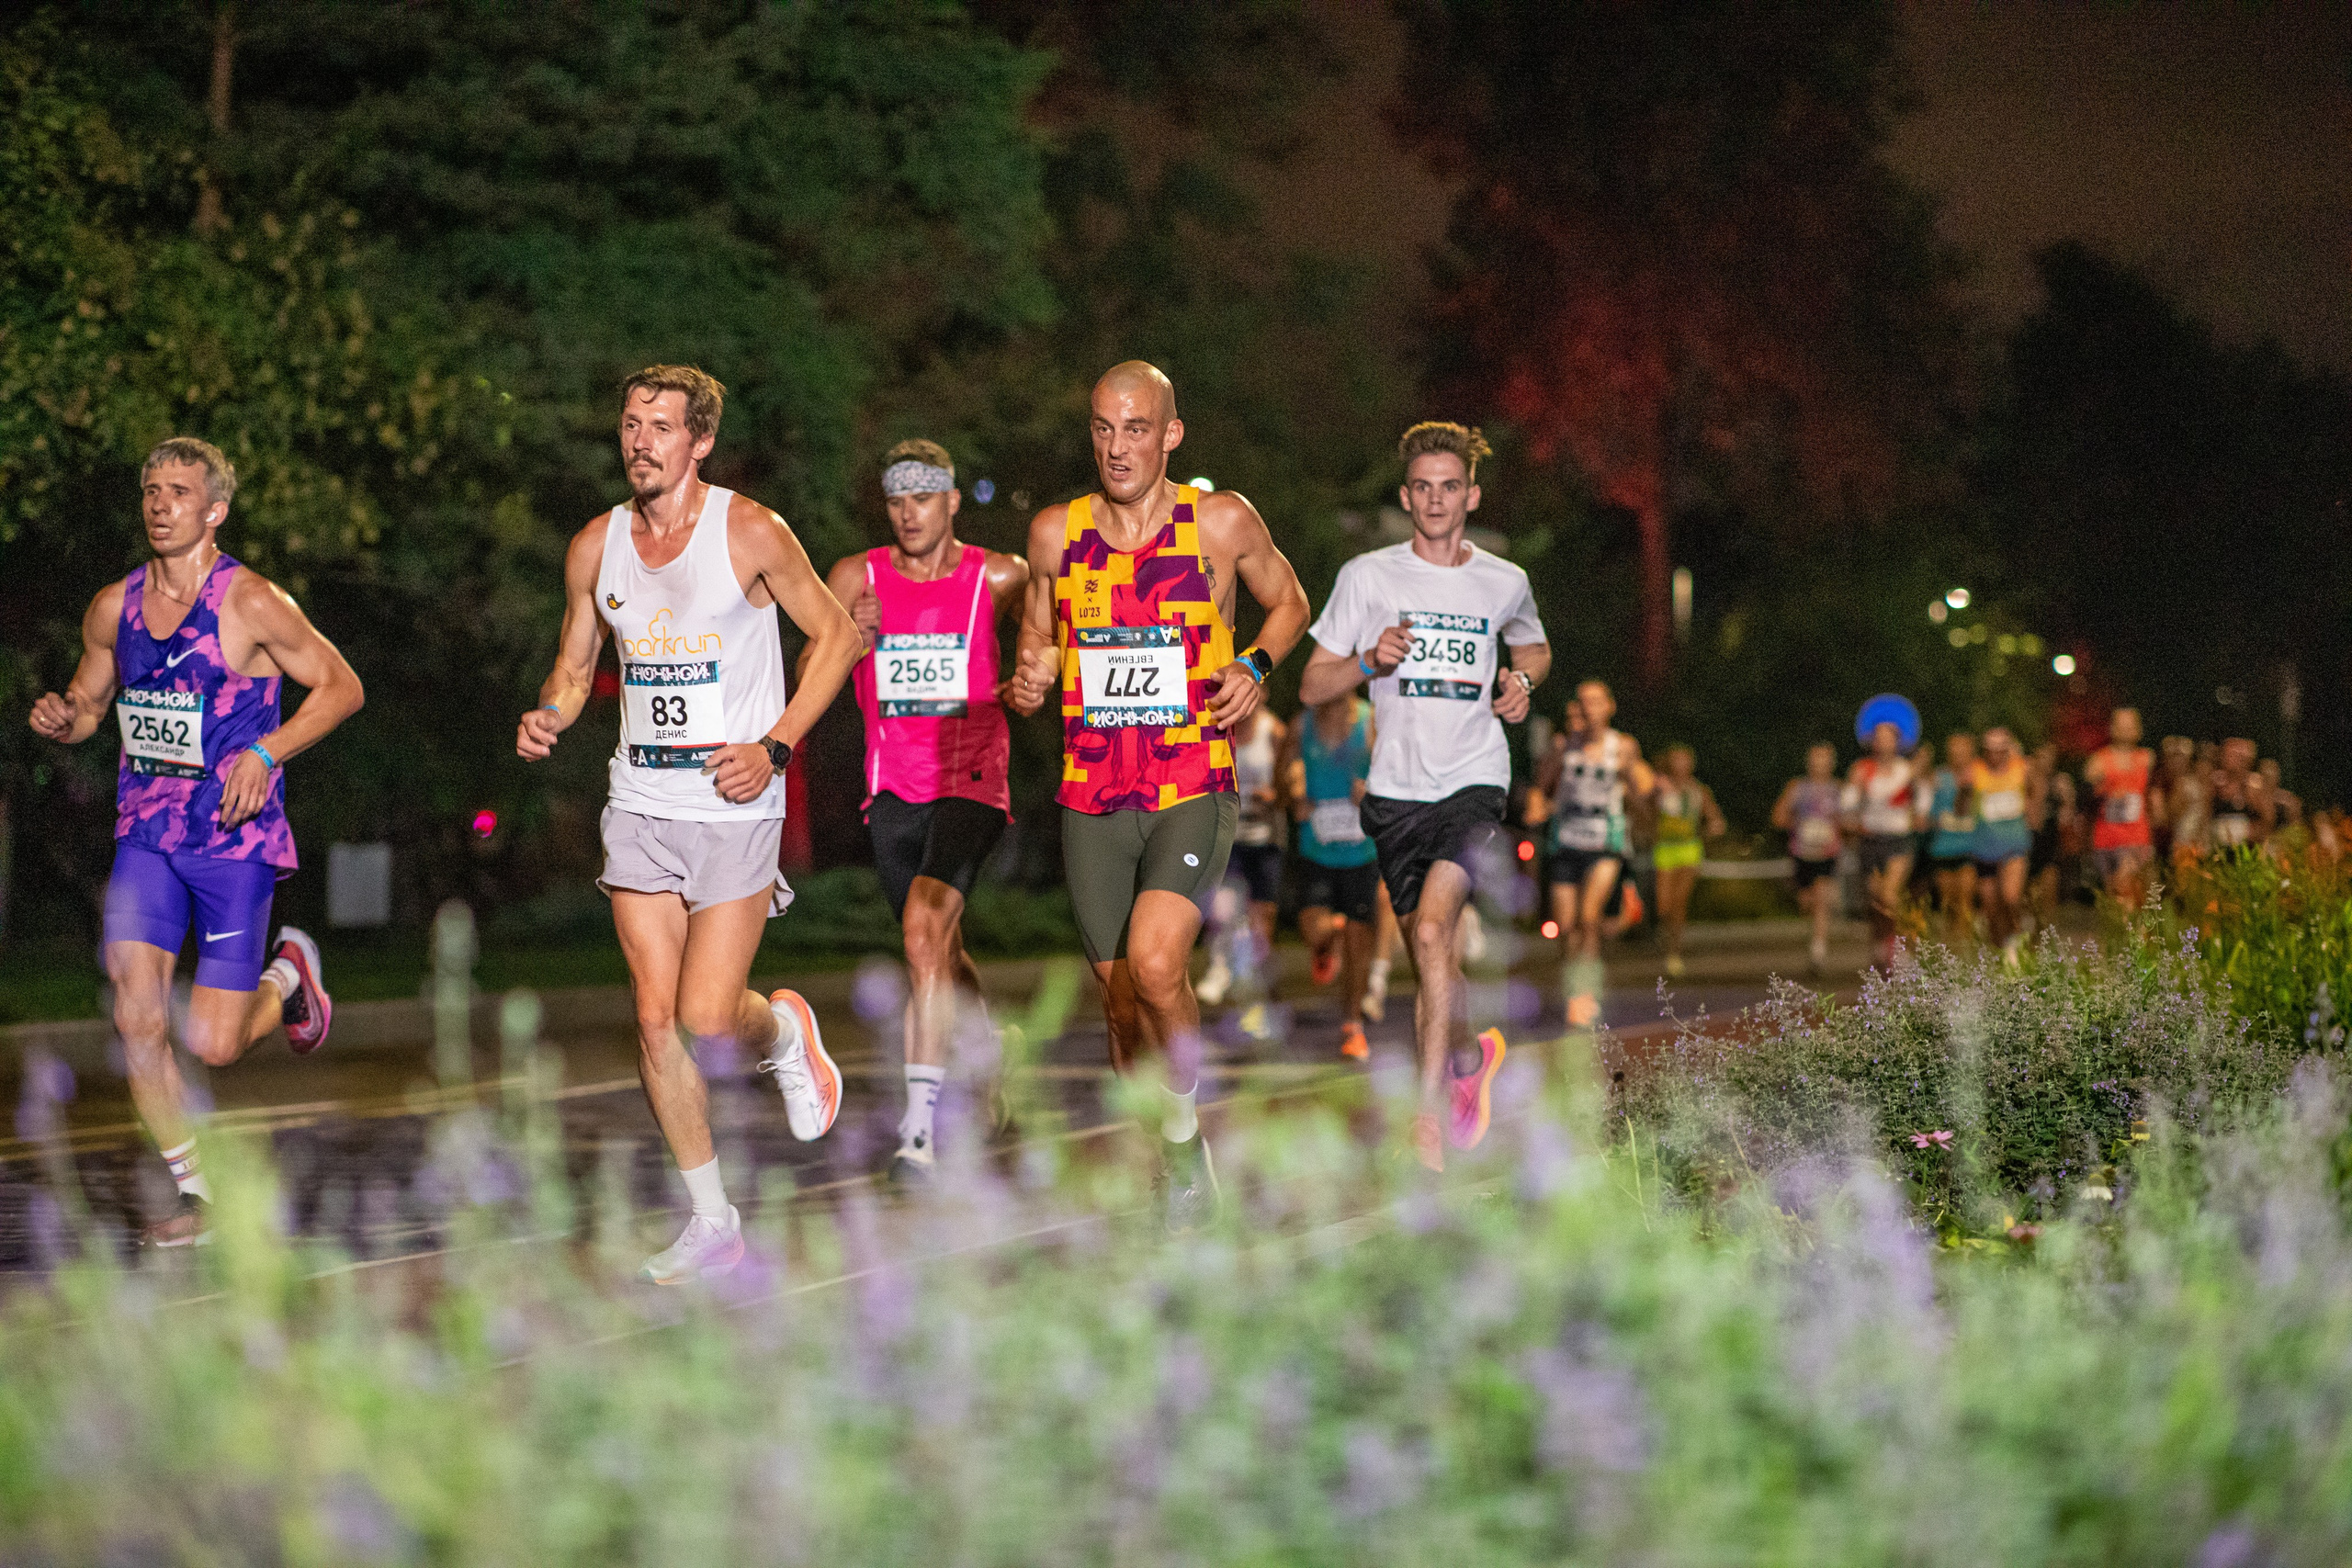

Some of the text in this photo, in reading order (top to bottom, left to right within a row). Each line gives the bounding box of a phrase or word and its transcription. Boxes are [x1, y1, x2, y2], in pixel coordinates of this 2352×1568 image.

[1107, 654, 1154, 666] ЕВГЕНИЙ
[1412, 637, 1476, 666] 3458
[631, 661, 711, 682] НОЧНОЙ
[888, 658, 956, 683] 2565
[1104, 667, 1160, 697] 277
[650, 695, 688, 727] 83
[1092, 710, 1176, 728] НОЧНОЙ
[129, 714, 191, 748] 2562
[655, 729, 688, 740] ДЕНИС
[140, 744, 185, 756] АЛЕКСАНДР
